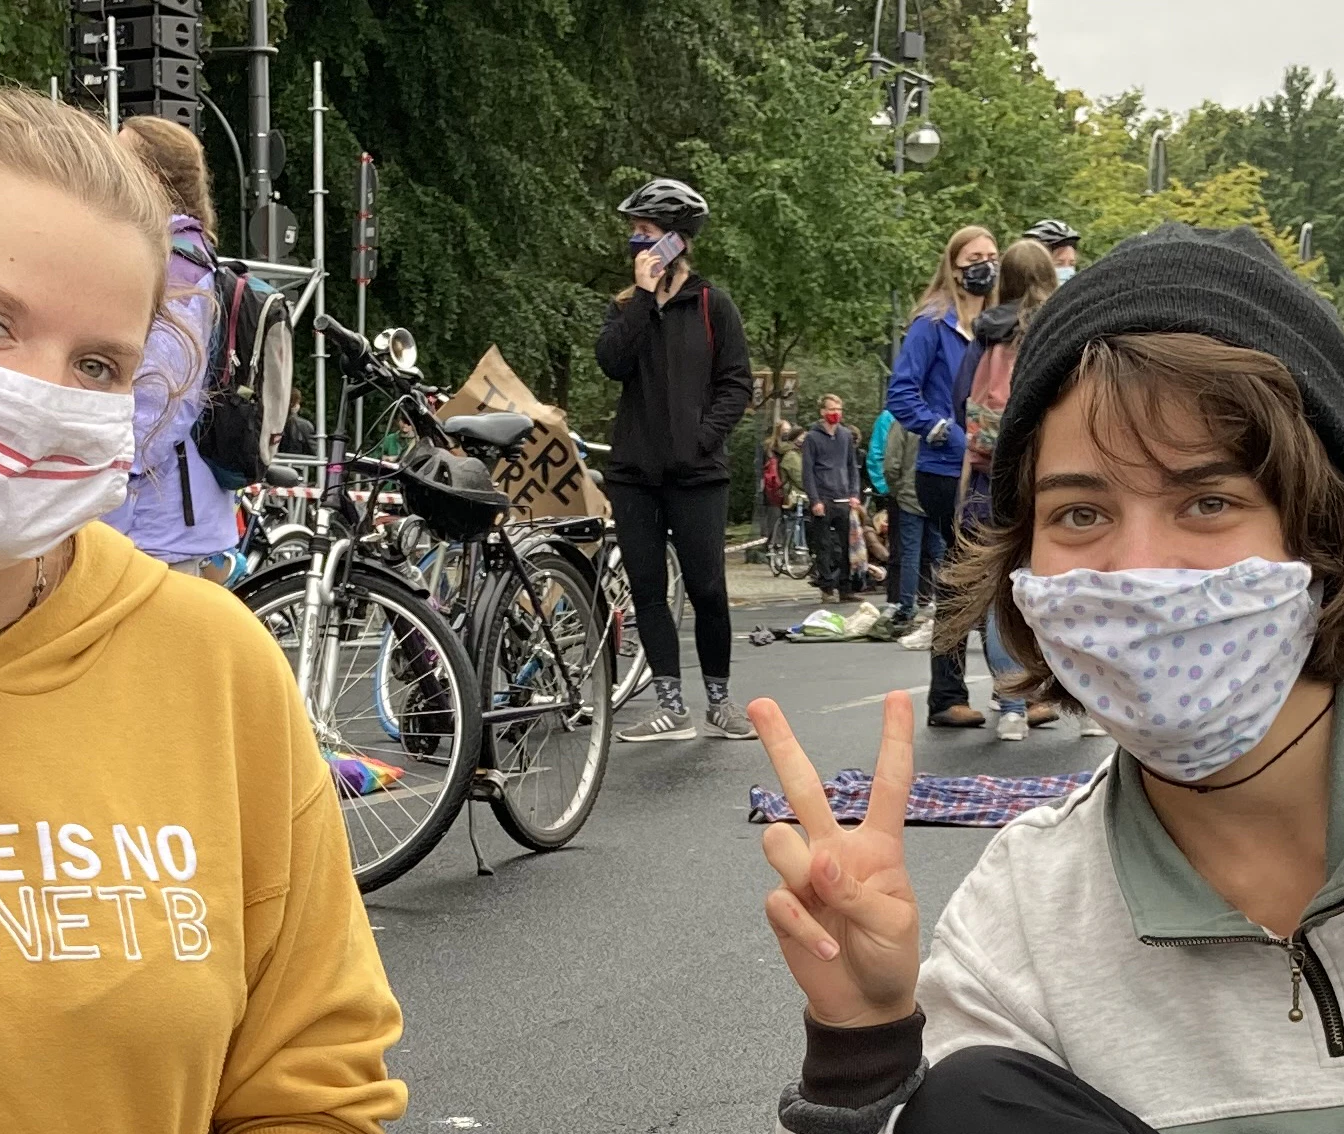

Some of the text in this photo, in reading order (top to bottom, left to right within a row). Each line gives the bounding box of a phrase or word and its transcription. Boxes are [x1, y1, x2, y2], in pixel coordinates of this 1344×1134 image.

[476, 375, 584, 506] TERE
[36, 821, 102, 882] IS
[112, 824, 198, 883] NO
[161, 886, 212, 963] B
